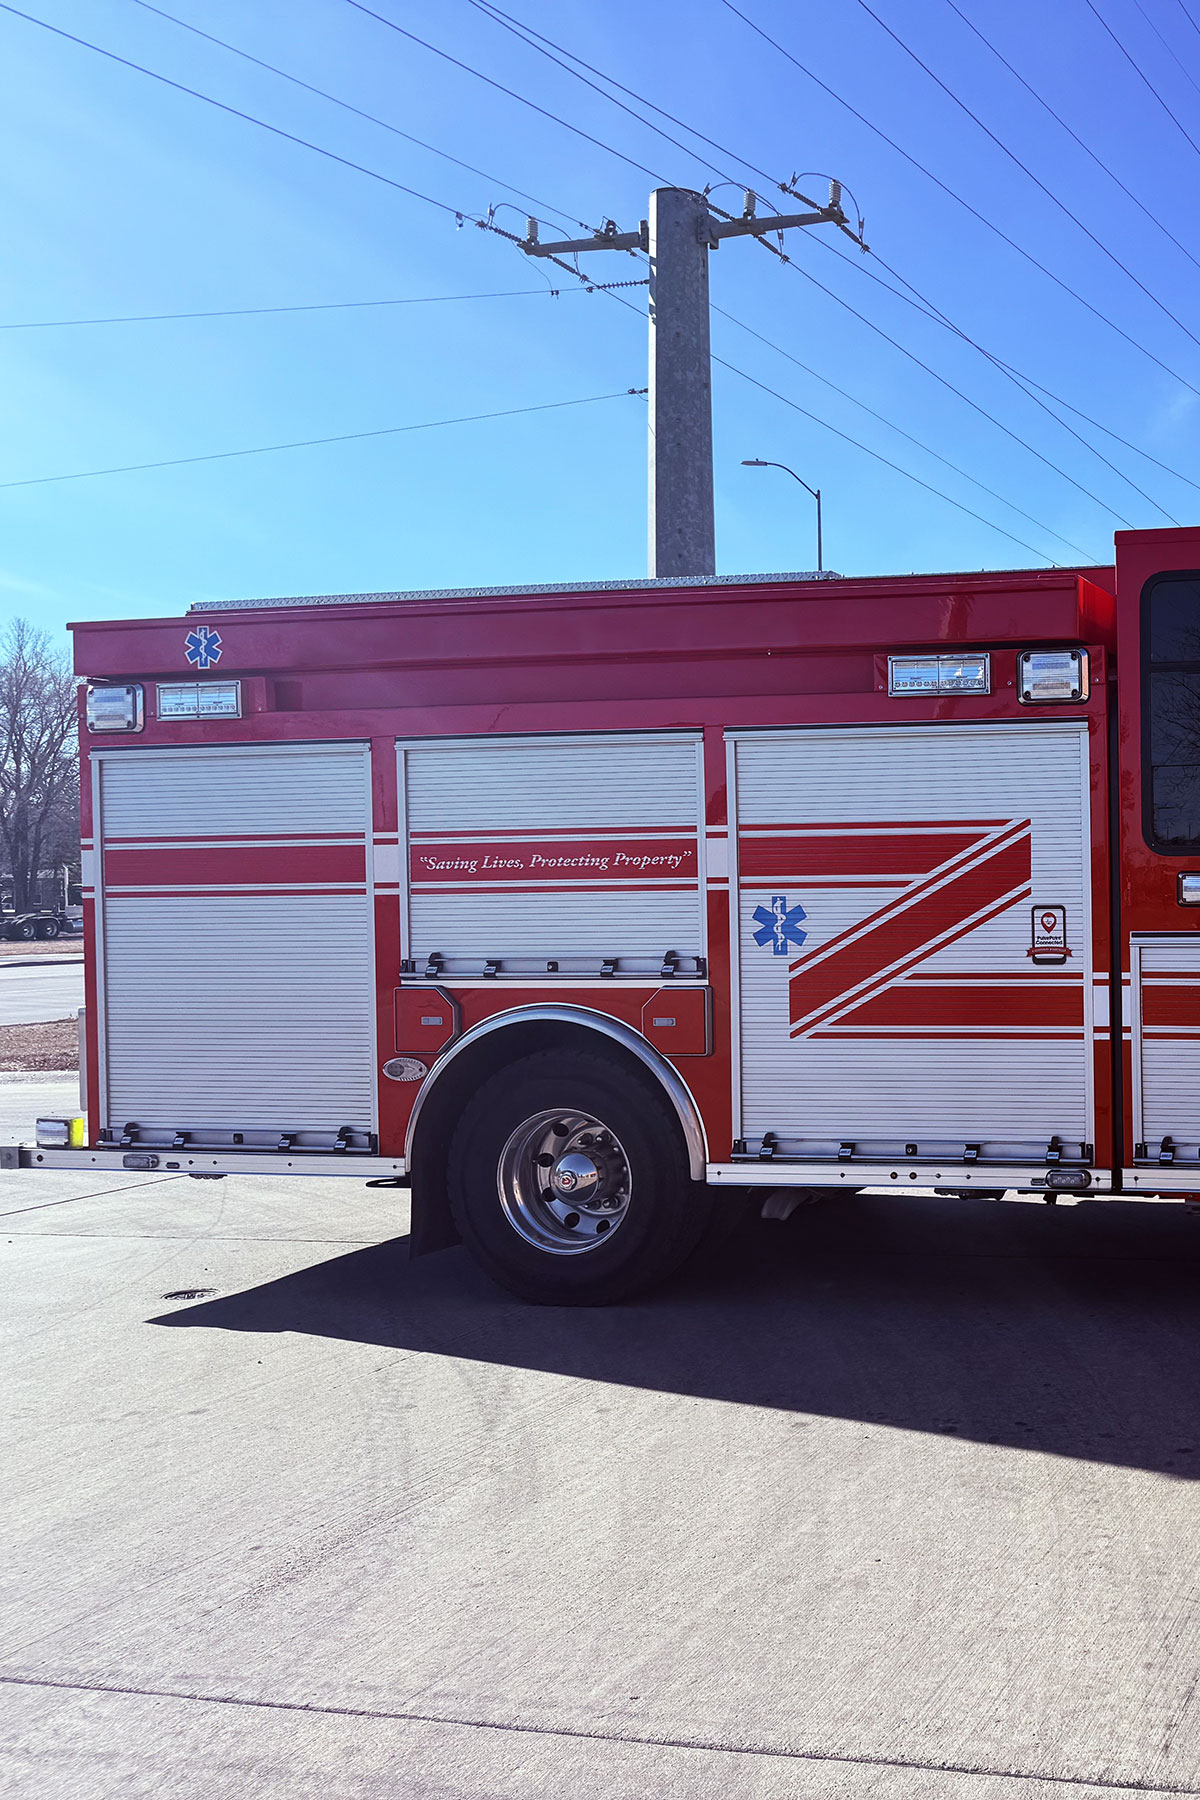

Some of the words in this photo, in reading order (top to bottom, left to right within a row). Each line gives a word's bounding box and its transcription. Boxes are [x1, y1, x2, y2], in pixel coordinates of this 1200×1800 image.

[420, 856, 477, 874] “Saving
[481, 855, 524, 870] Lives,
[529, 853, 609, 870] Protecting
[613, 850, 692, 870] Property”
